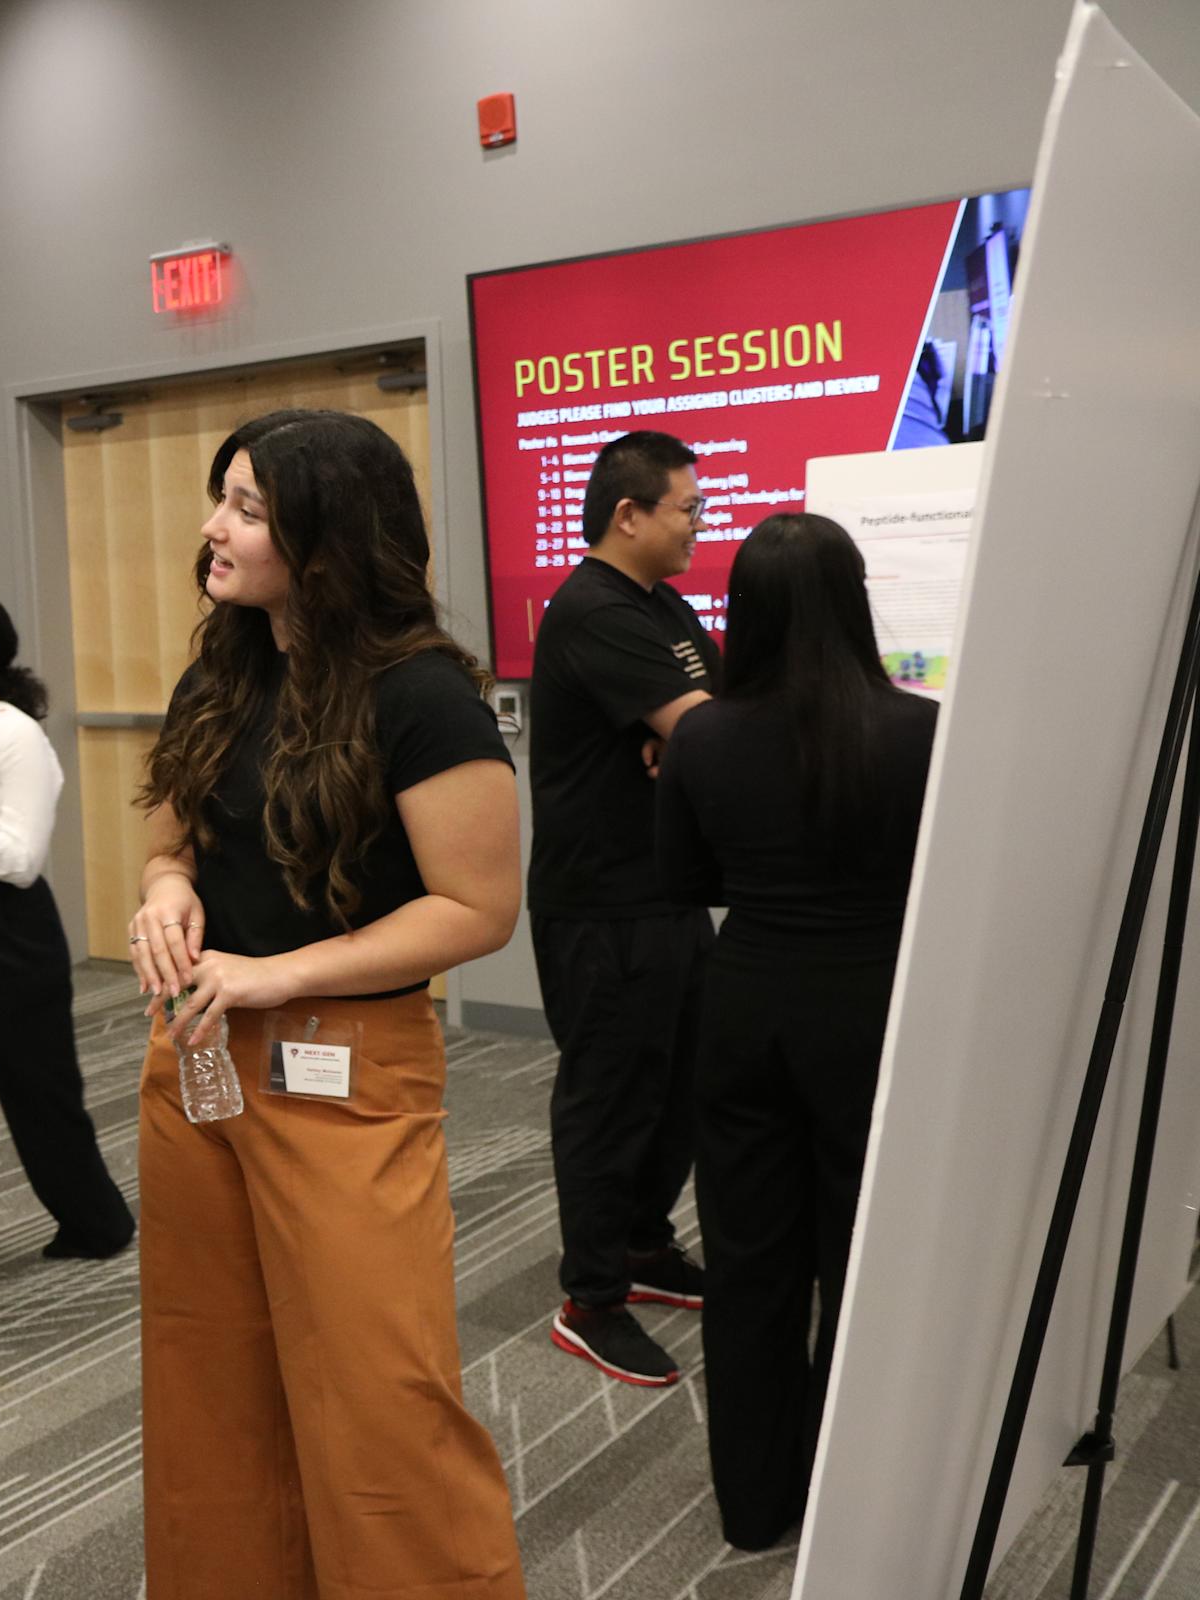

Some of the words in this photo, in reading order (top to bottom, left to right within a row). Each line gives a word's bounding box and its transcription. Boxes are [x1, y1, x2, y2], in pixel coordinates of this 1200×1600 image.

[163, 254, 212, 309] EXIT
[514, 344, 655, 398] POSTER
[668, 320, 842, 380] SESSION
[517, 408, 559, 427] JUDGES
[559, 404, 603, 423] PLEASE
[603, 401, 631, 418] FIND
[631, 397, 666, 415] YOUR
[666, 391, 728, 412] ASSIGNED
[728, 384, 793, 406] CLUSTERS
[793, 381, 824, 399] AND
[824, 374, 880, 396] REVIEW
